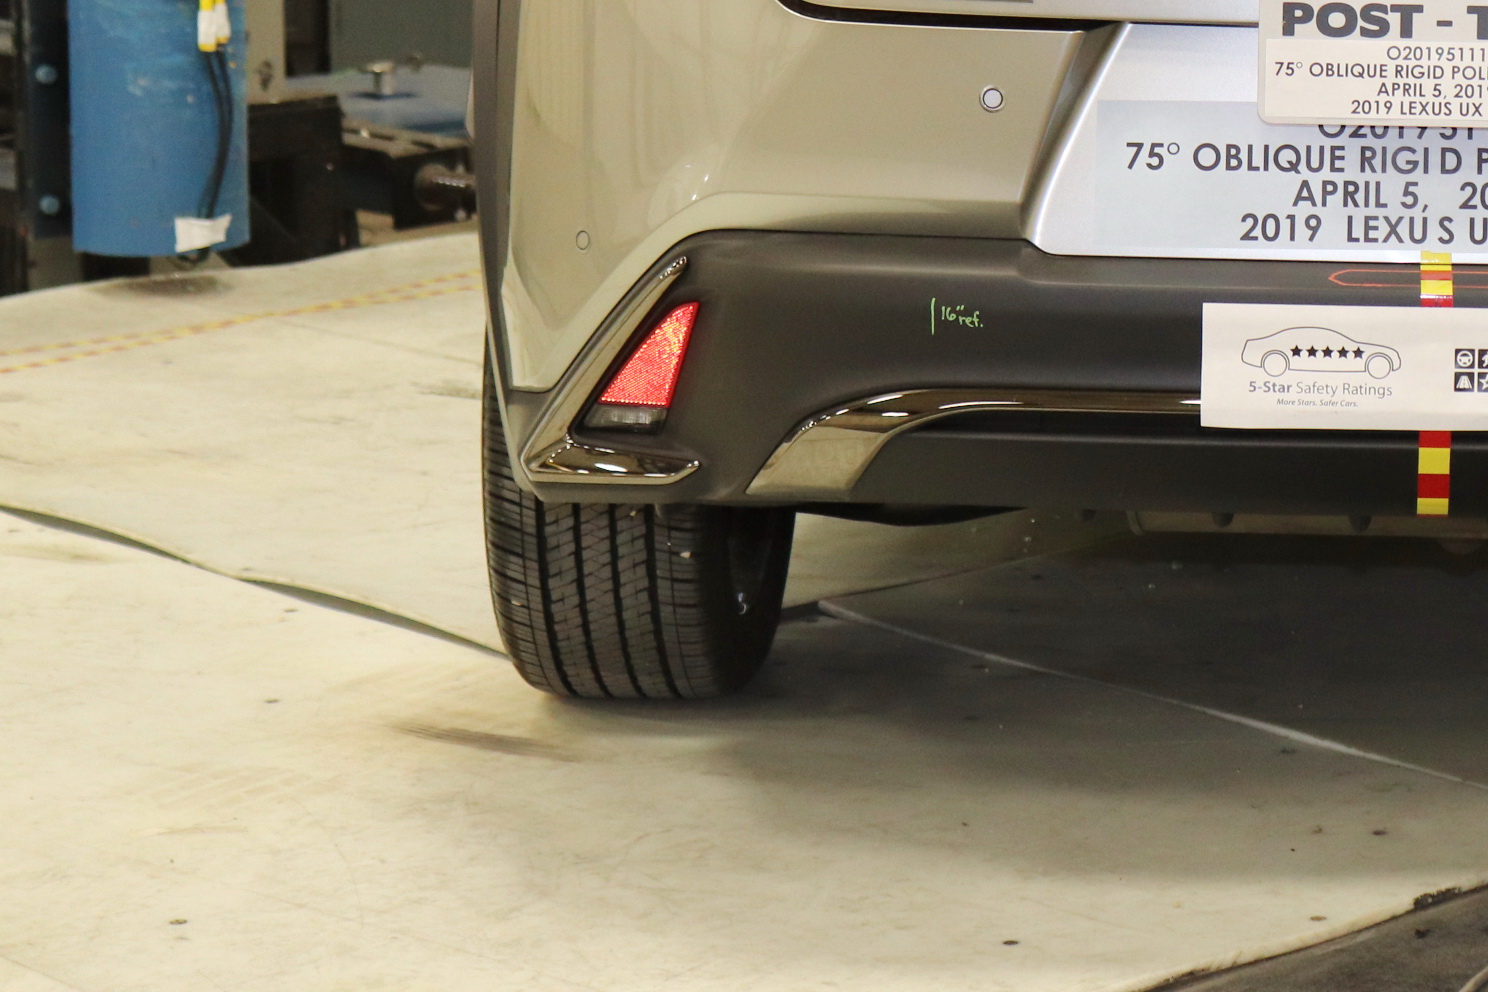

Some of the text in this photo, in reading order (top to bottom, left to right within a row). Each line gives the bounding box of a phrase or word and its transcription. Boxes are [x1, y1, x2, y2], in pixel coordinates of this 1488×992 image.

[1281, 1, 1424, 39] POST
[1274, 61, 1303, 77] 75°
[1309, 62, 1388, 79] OBLIQUE
[1394, 64, 1445, 80] RIGID
[1376, 82, 1426, 98] APRIL
[1432, 83, 1448, 100] 5,
[1350, 99, 1393, 115] 2019
[1400, 101, 1452, 116] LEXUS
[1459, 102, 1483, 117] UX
[1126, 142, 1180, 171] 75°
[1193, 142, 1346, 175] OBLIQUE
[1359, 146, 1463, 176] RIGID
[1291, 179, 1389, 209] APRIL
[1400, 181, 1429, 213] 5,
[1239, 213, 1322, 242] 2019
[1346, 215, 1455, 245] LEXUS
[1249, 381, 1392, 399] 5-Star Safety Ratings
[1276, 398, 1359, 408] More Stars. Safer Cars.
